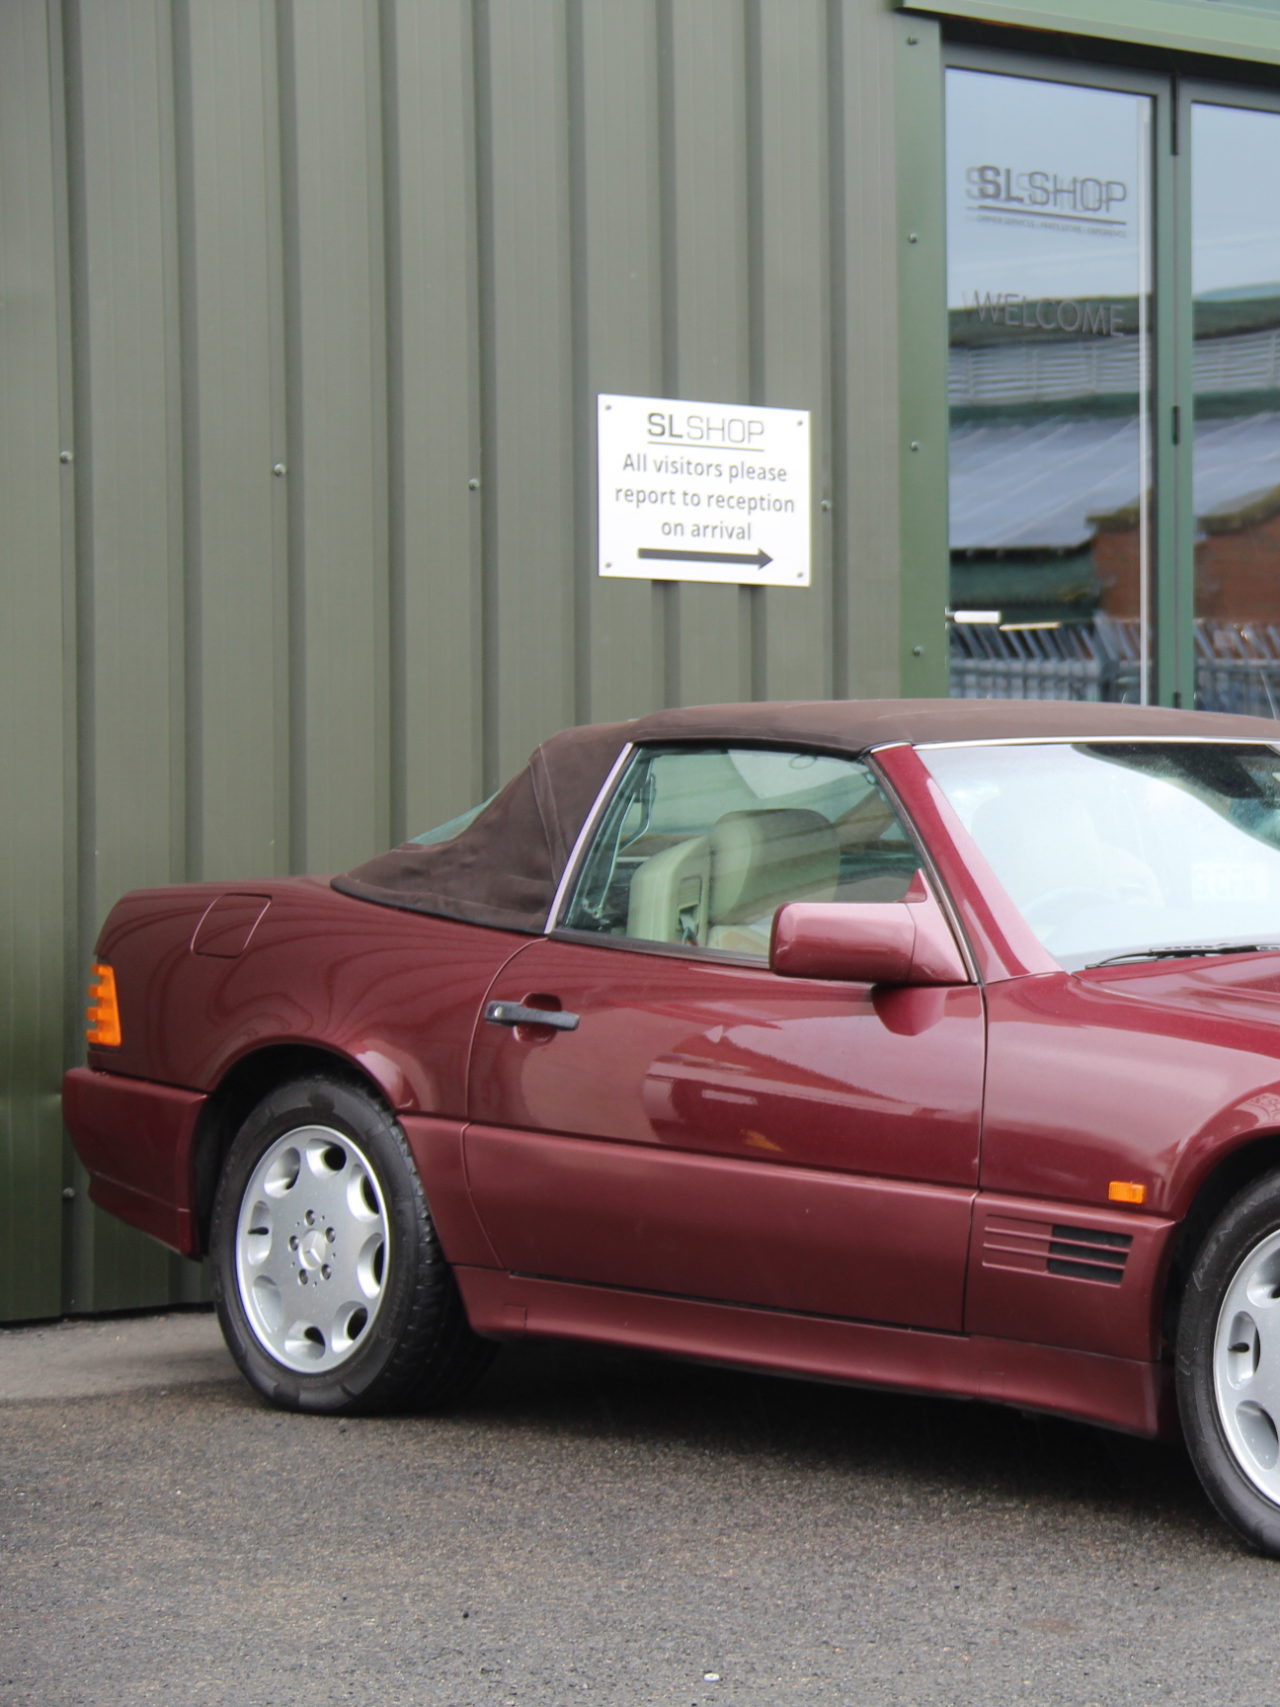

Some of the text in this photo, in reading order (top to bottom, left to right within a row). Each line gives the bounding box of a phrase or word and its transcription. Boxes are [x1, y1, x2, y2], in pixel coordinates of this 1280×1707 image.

[977, 165, 1127, 212] SLSHOP
[974, 290, 1125, 337] WELCOME
[623, 454, 787, 483] All visitors please
[615, 487, 795, 515] report to reception
[661, 520, 752, 541] on arrival
